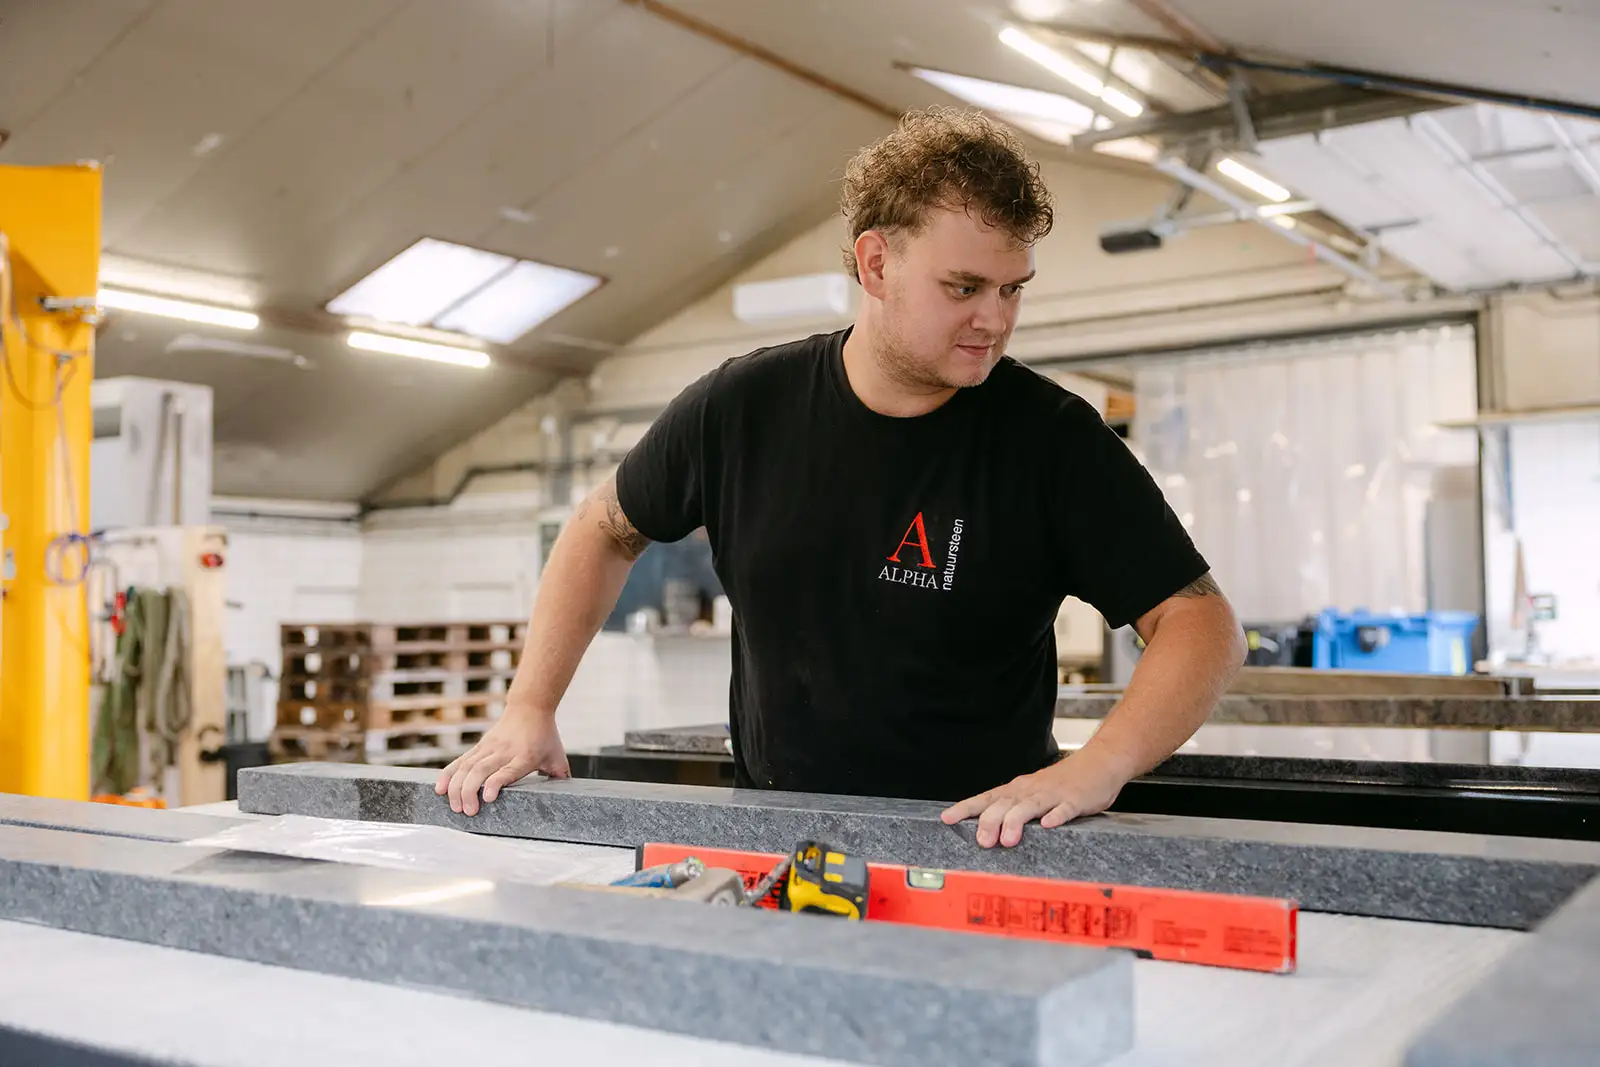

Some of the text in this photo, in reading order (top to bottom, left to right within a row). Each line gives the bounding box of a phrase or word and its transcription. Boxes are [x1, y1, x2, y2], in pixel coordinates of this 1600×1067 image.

[886, 511, 937, 569] A
[942, 518, 964, 591] natuursteen
[878, 565, 939, 590] ALPHA
